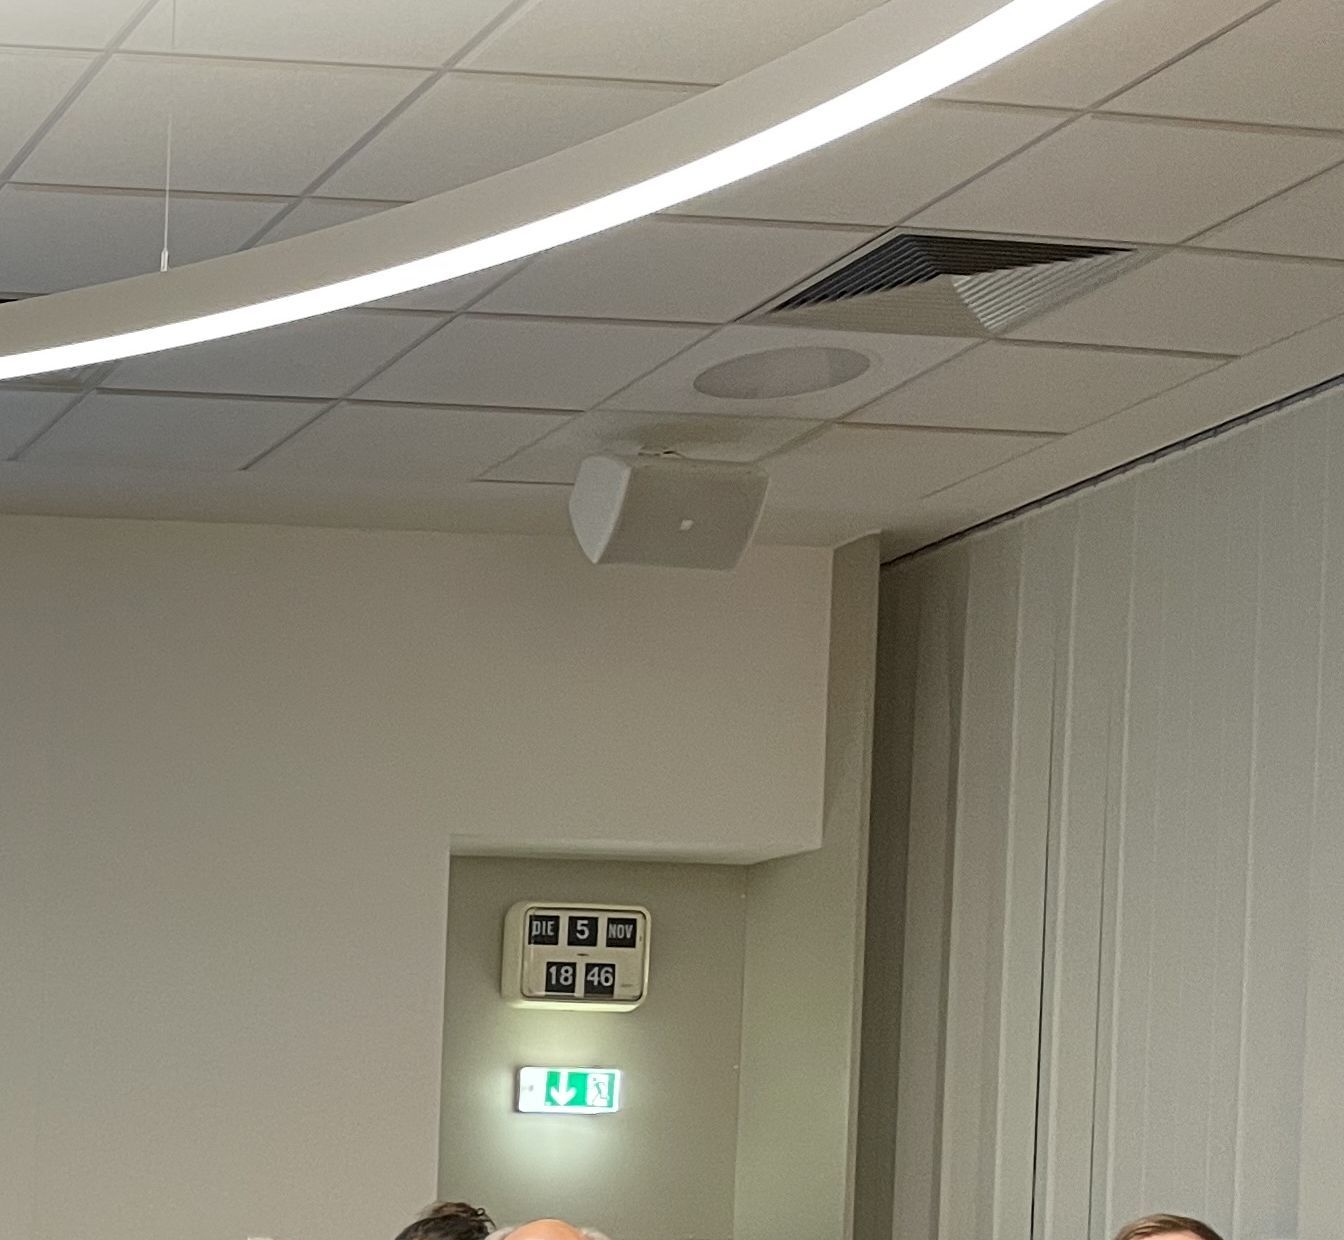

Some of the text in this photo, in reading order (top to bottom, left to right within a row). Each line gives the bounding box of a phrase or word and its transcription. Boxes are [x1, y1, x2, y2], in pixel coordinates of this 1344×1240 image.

[532, 920, 633, 939] DIE 5 NOV
[549, 965, 613, 986] 18 46
